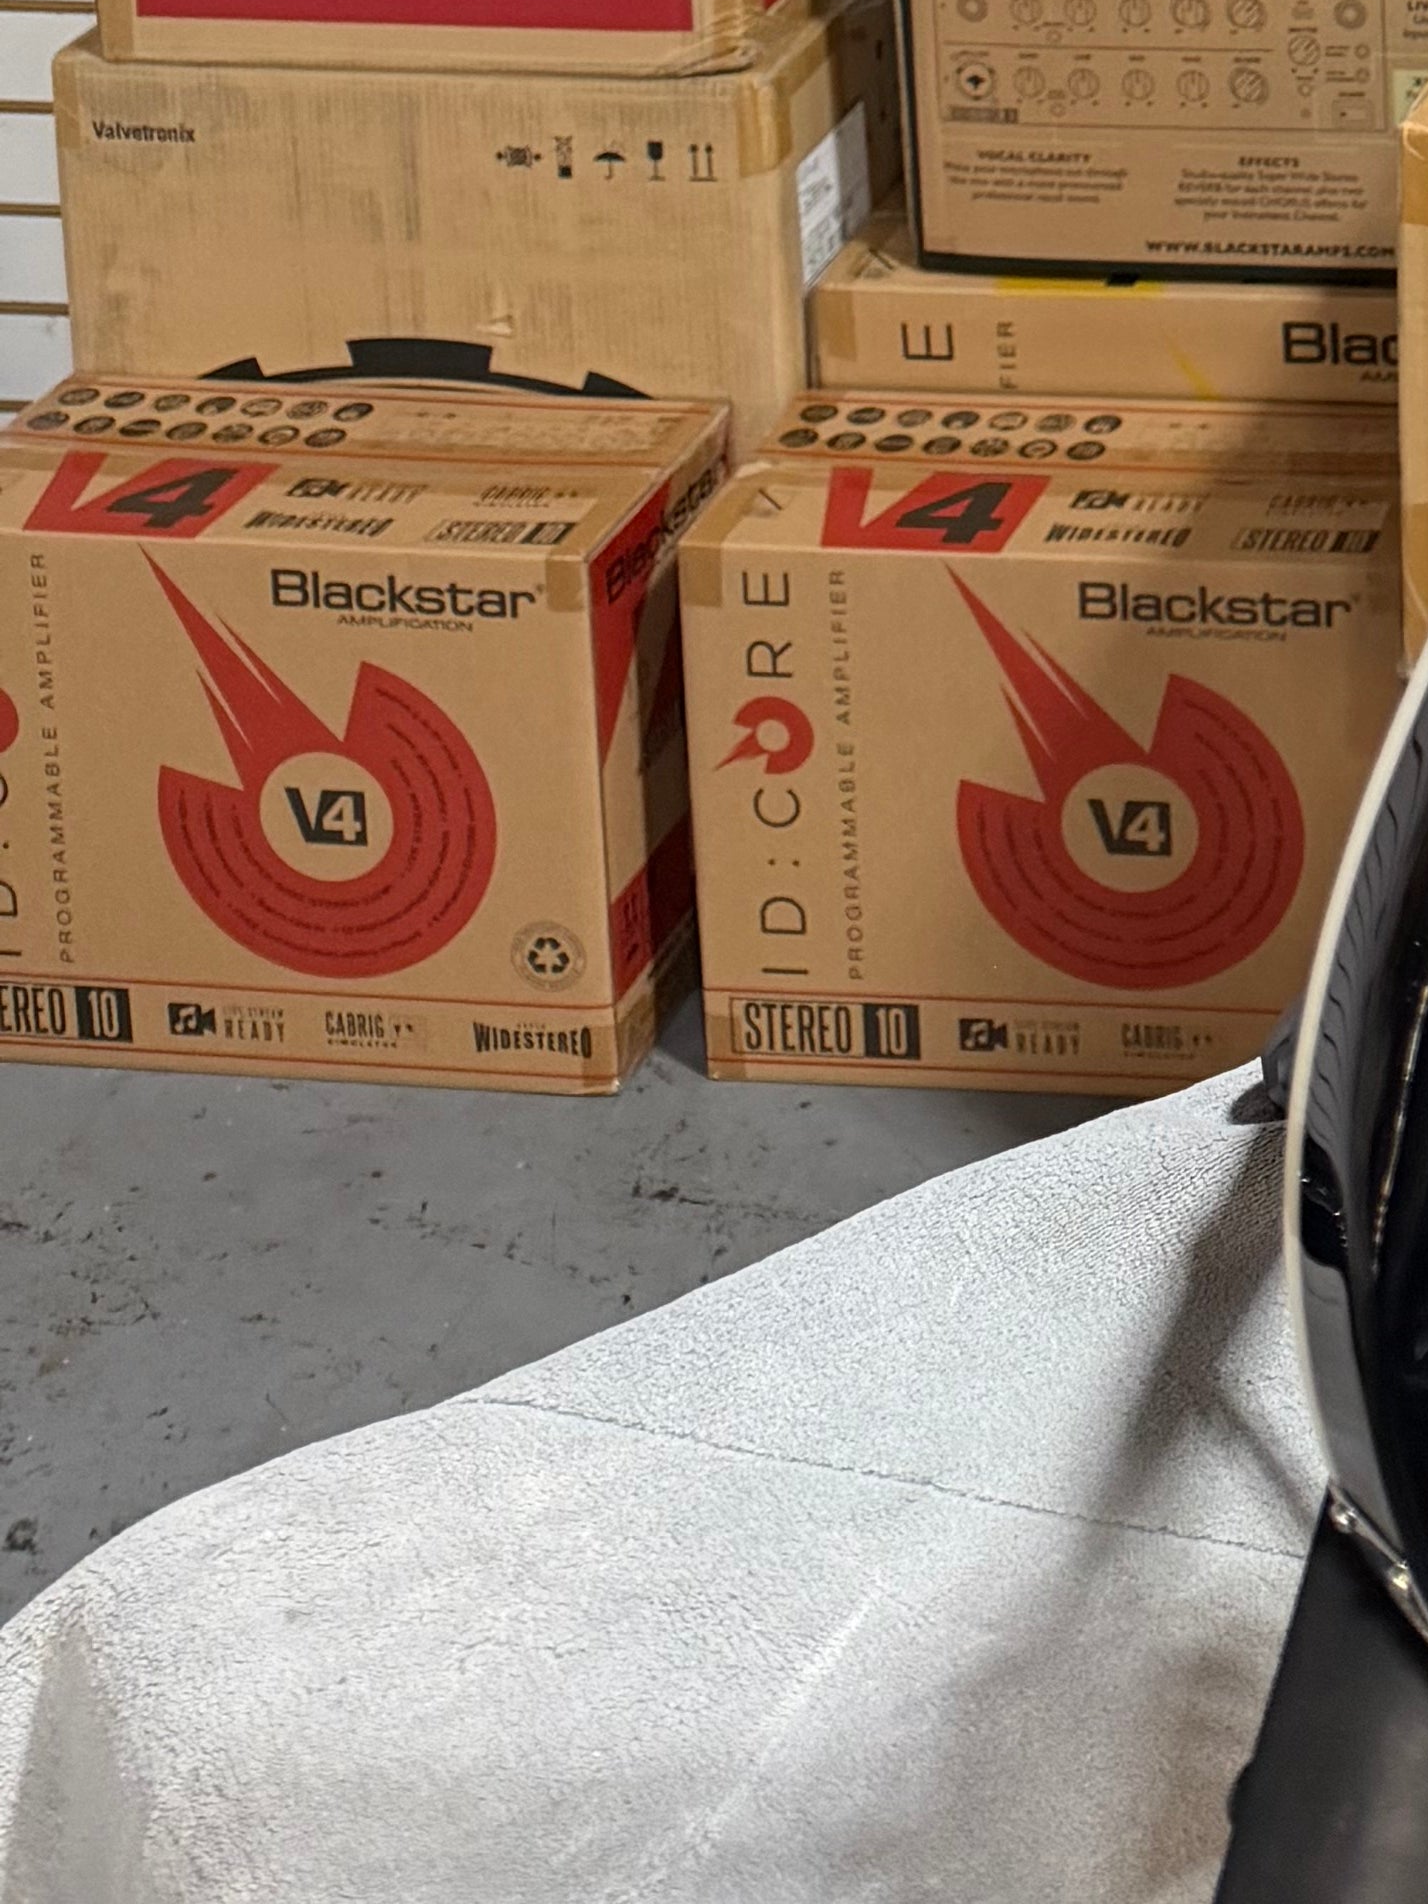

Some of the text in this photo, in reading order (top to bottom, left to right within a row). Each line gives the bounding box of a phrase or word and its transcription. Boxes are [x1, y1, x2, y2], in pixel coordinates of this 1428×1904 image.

[91, 119, 196, 145] Valvetronix
[270, 568, 537, 619] Blackstar
[1077, 580, 1352, 629] Blackstar
[30, 552, 76, 964] PROGRAMMABLE AMPLIFIER
[828, 568, 866, 981] PROGRAMMABLE AMPLIFIER
[284, 785, 368, 847] V4
[1086, 797, 1172, 857] V4
[0, 986, 121, 1040] EREO 10
[223, 1020, 286, 1044] READY
[324, 1010, 385, 1039] CABRIG
[744, 1002, 908, 1056] STEREO 10
[473, 1021, 593, 1060] WIDESTEREO
